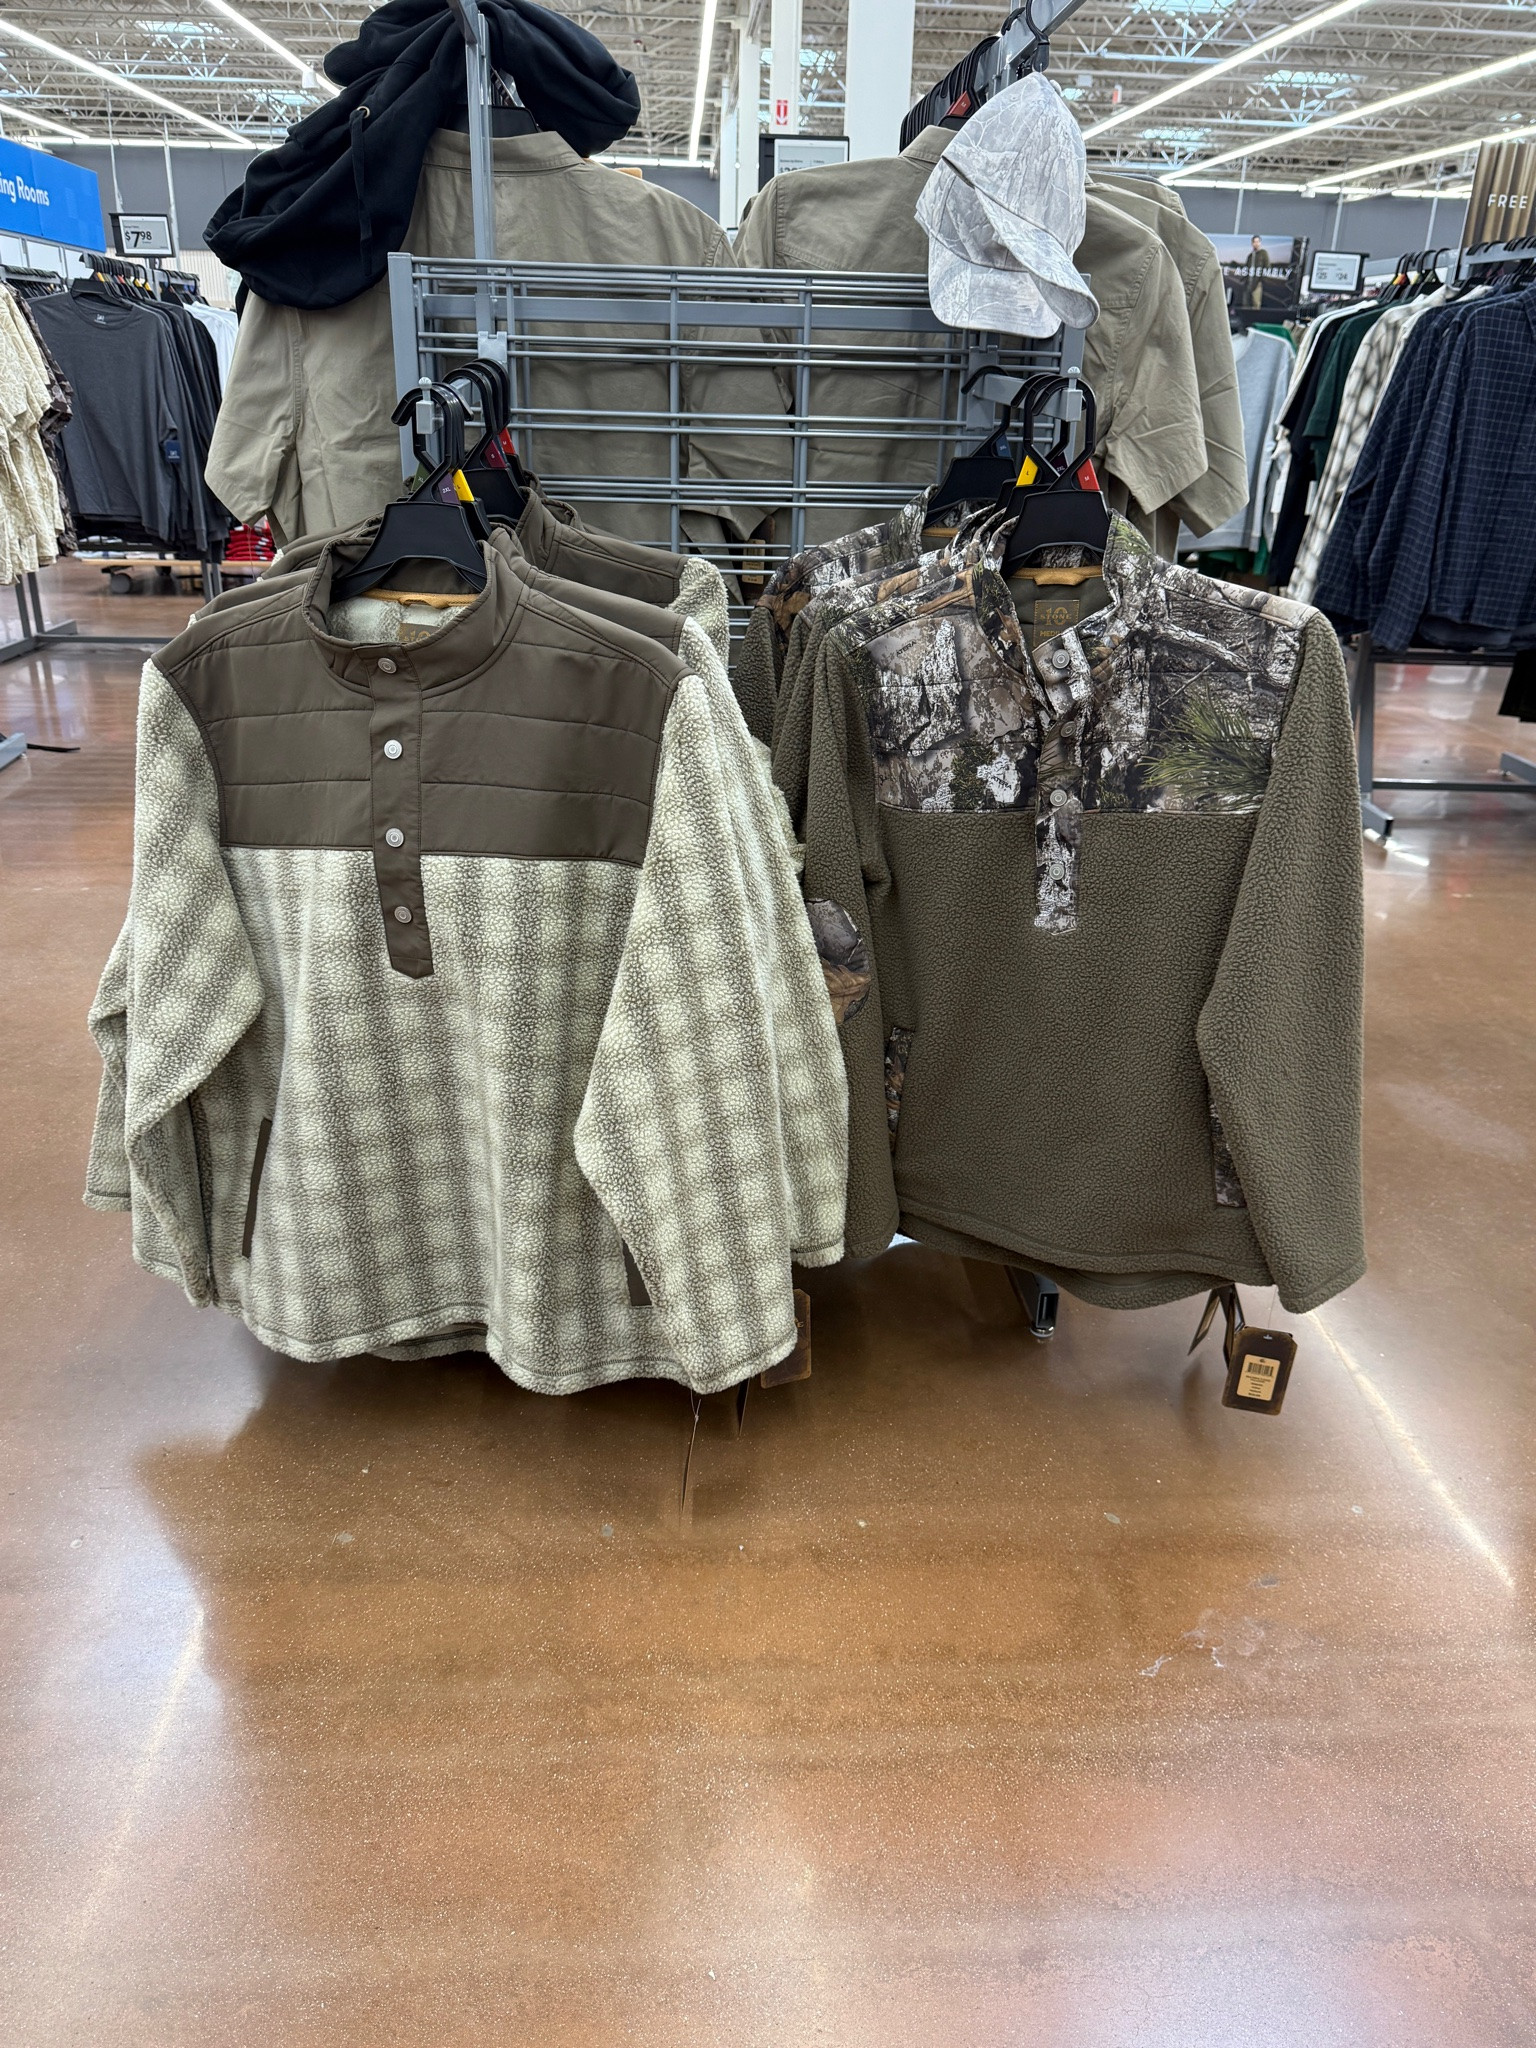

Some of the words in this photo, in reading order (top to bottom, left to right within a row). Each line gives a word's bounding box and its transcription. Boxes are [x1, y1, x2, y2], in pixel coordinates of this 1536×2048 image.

[16, 175, 50, 207] Rooms
[1487, 193, 1529, 209] FREE
[1234, 266, 1293, 279] ASSEMBLY
[442, 486, 452, 494] 2XL
[1043, 606, 1068, 626] 10
[1039, 630, 1062, 638] MEDI
